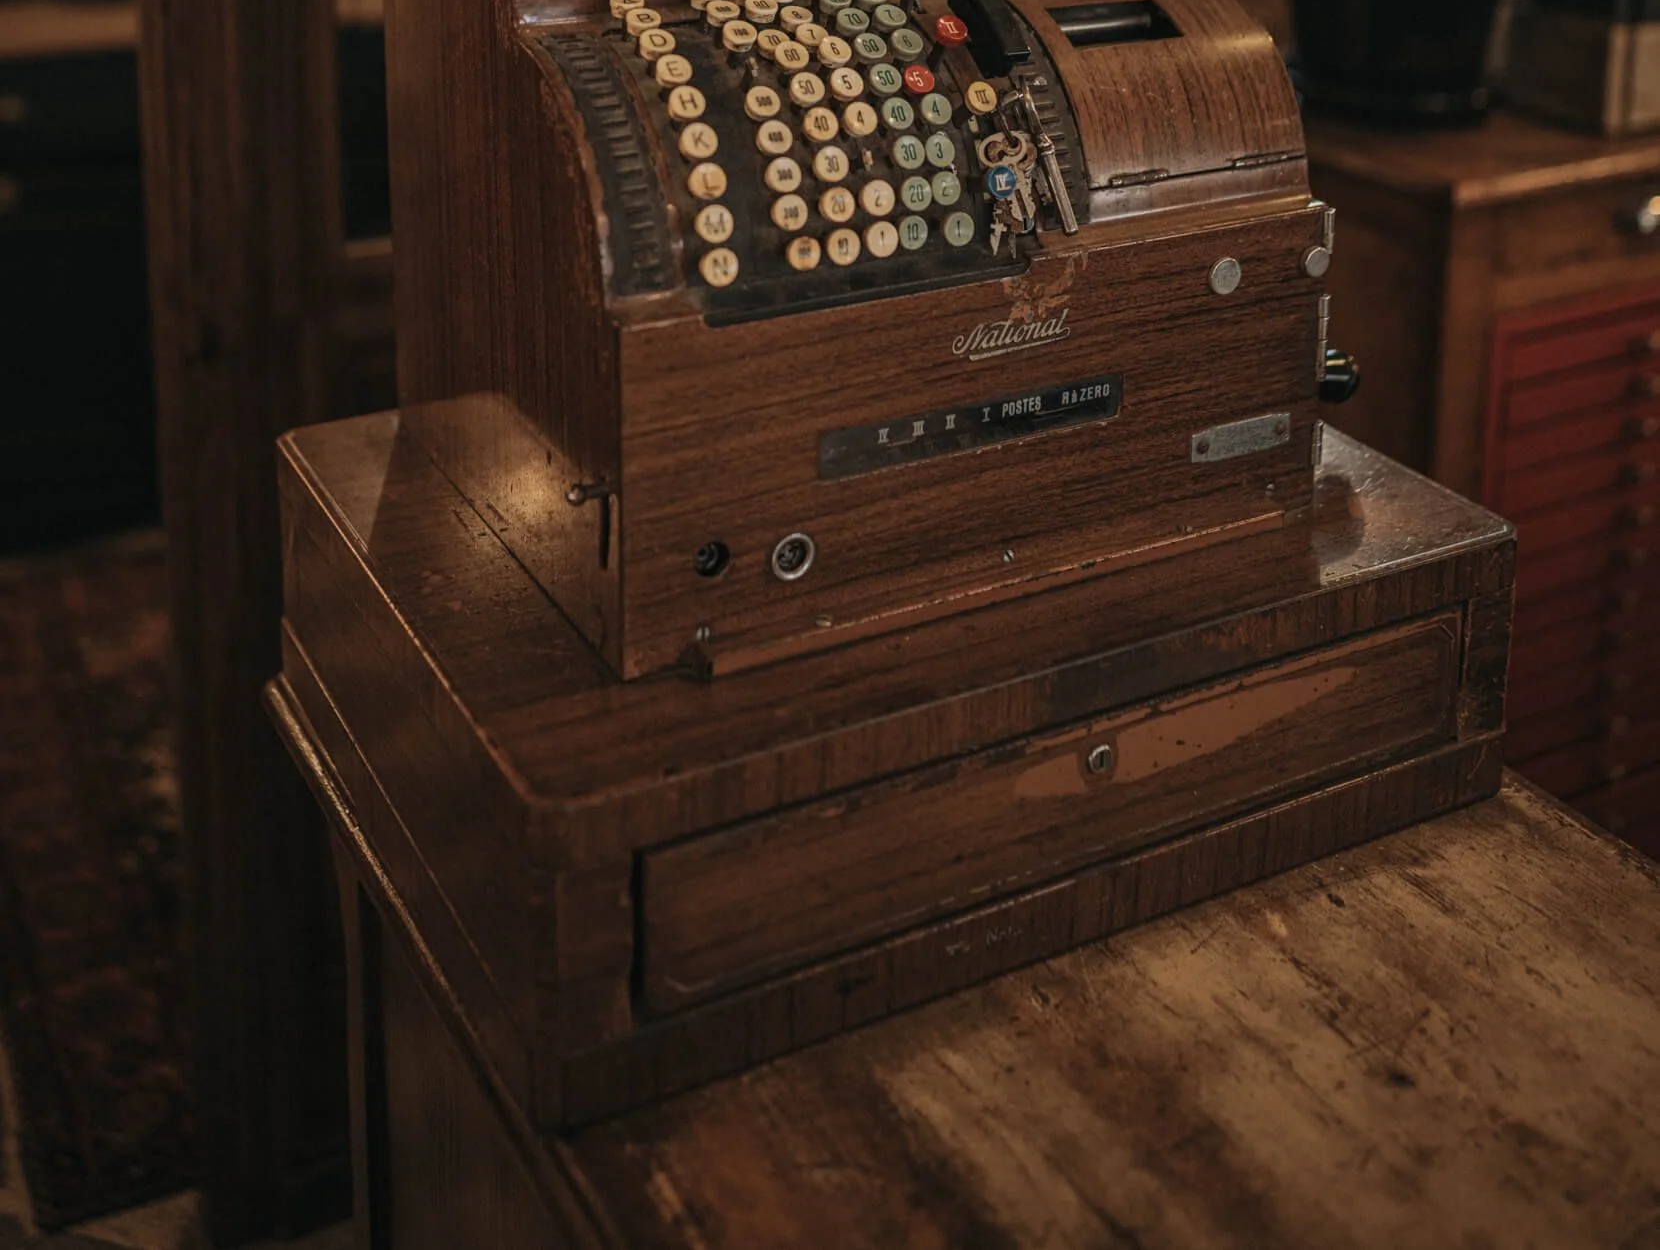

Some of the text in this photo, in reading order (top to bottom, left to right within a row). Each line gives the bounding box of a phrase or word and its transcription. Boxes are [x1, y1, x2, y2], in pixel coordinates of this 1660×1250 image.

[636, 13, 654, 23] B
[845, 13, 862, 25] 70
[883, 9, 896, 21] 7
[649, 34, 667, 48] D
[765, 34, 781, 47] 70
[806, 29, 817, 40] 7
[902, 35, 913, 48] 6
[830, 42, 841, 55] 6
[862, 38, 880, 53] 60
[783, 48, 801, 62] 60
[666, 60, 684, 78] E
[841, 74, 853, 90] 5
[877, 70, 896, 86] 50
[911, 71, 925, 87] 5
[799, 80, 816, 95] 50
[678, 93, 699, 111] H
[932, 101, 941, 117] 4
[856, 109, 866, 125] 4
[891, 105, 906, 122] 40
[813, 115, 830, 132] 40
[691, 131, 709, 149] K
[901, 143, 917, 161] 30
[935, 141, 944, 159] 3
[824, 155, 840, 173] 30
[702, 172, 721, 191] L
[909, 184, 924, 203] 20
[906, 222, 919, 241] 10
[952, 308, 1071, 355] National
[945, 414, 956, 430] II
[981, 407, 992, 423] I
[1001, 395, 1042, 419] POSTES
